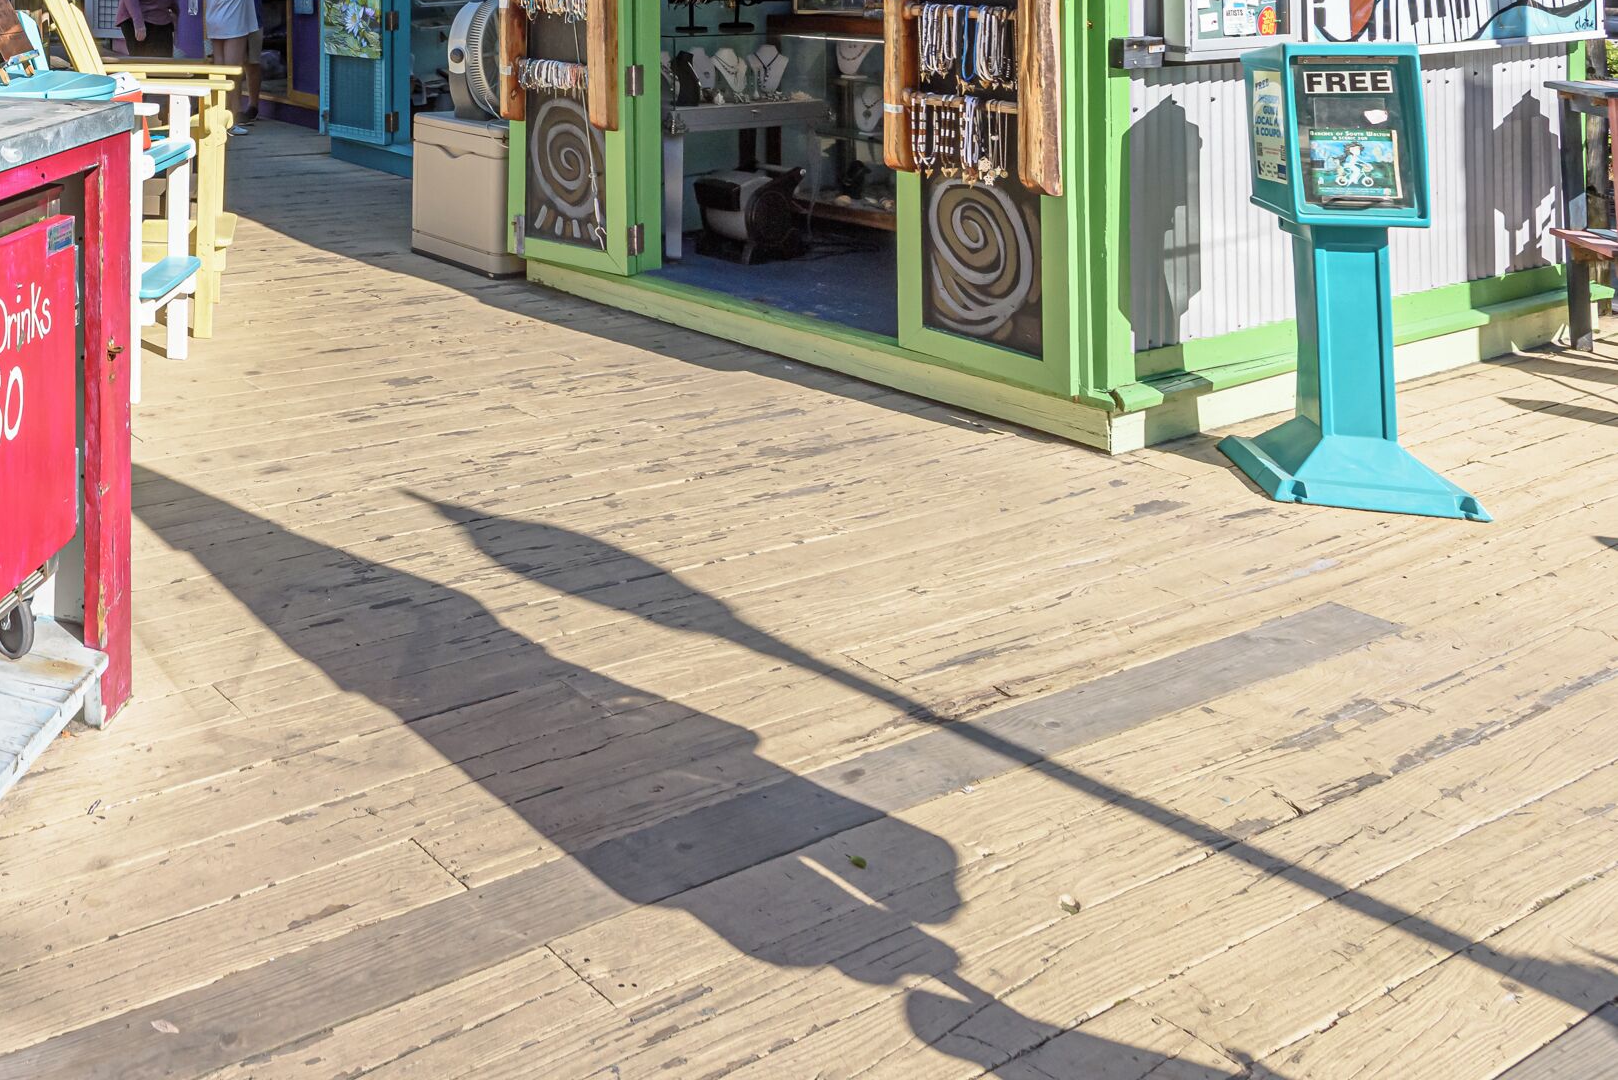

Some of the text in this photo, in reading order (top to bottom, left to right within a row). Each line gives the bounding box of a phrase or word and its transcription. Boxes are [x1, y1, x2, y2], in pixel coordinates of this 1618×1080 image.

[1225, 9, 1244, 17] ARTISTS
[1255, 78, 1270, 92] FREE
[1305, 71, 1391, 93] FREE
